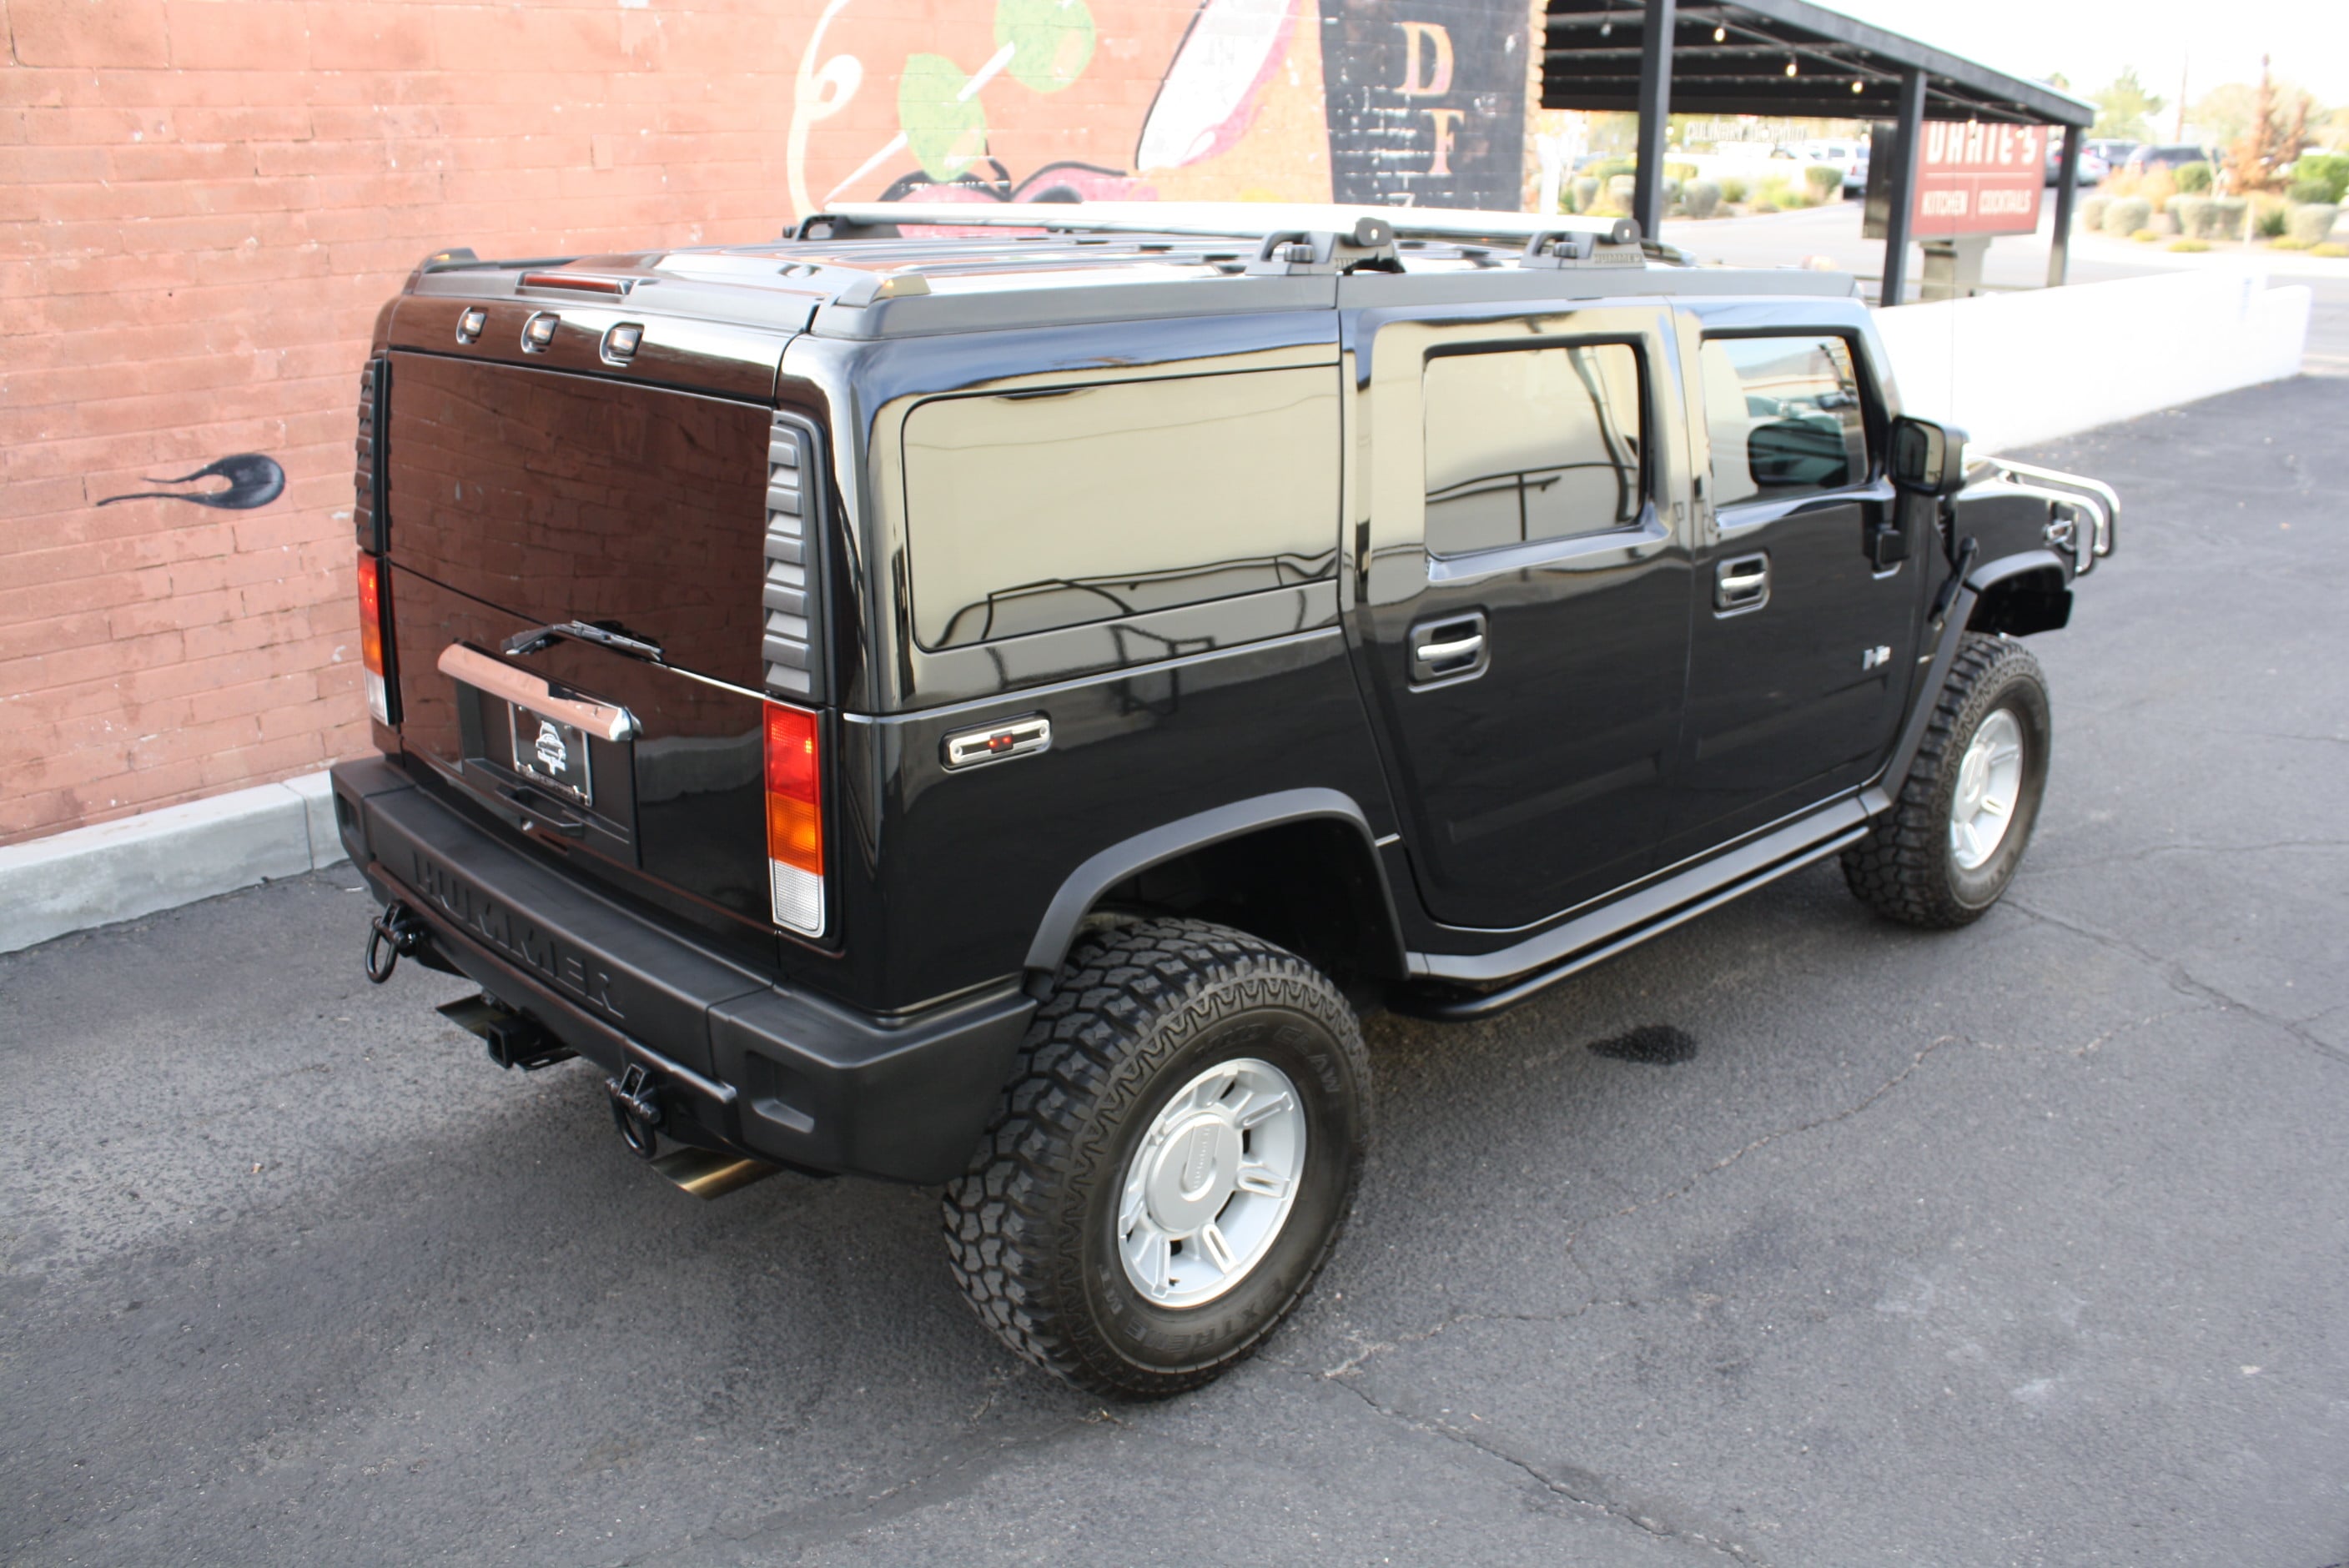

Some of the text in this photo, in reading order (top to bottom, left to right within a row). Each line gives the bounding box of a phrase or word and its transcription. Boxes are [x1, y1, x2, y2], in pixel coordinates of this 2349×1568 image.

[1393, 21, 1455, 97] D
[1421, 108, 1466, 177] F
[1926, 121, 2038, 165] DANTES
[1920, 189, 1969, 216] KITCHEN
[1977, 188, 2033, 215] COCKTAILS
[1862, 646, 1892, 672] H2
[414, 851, 626, 1019] HUMMER
[1273, 1025, 1342, 1093] CLAW
